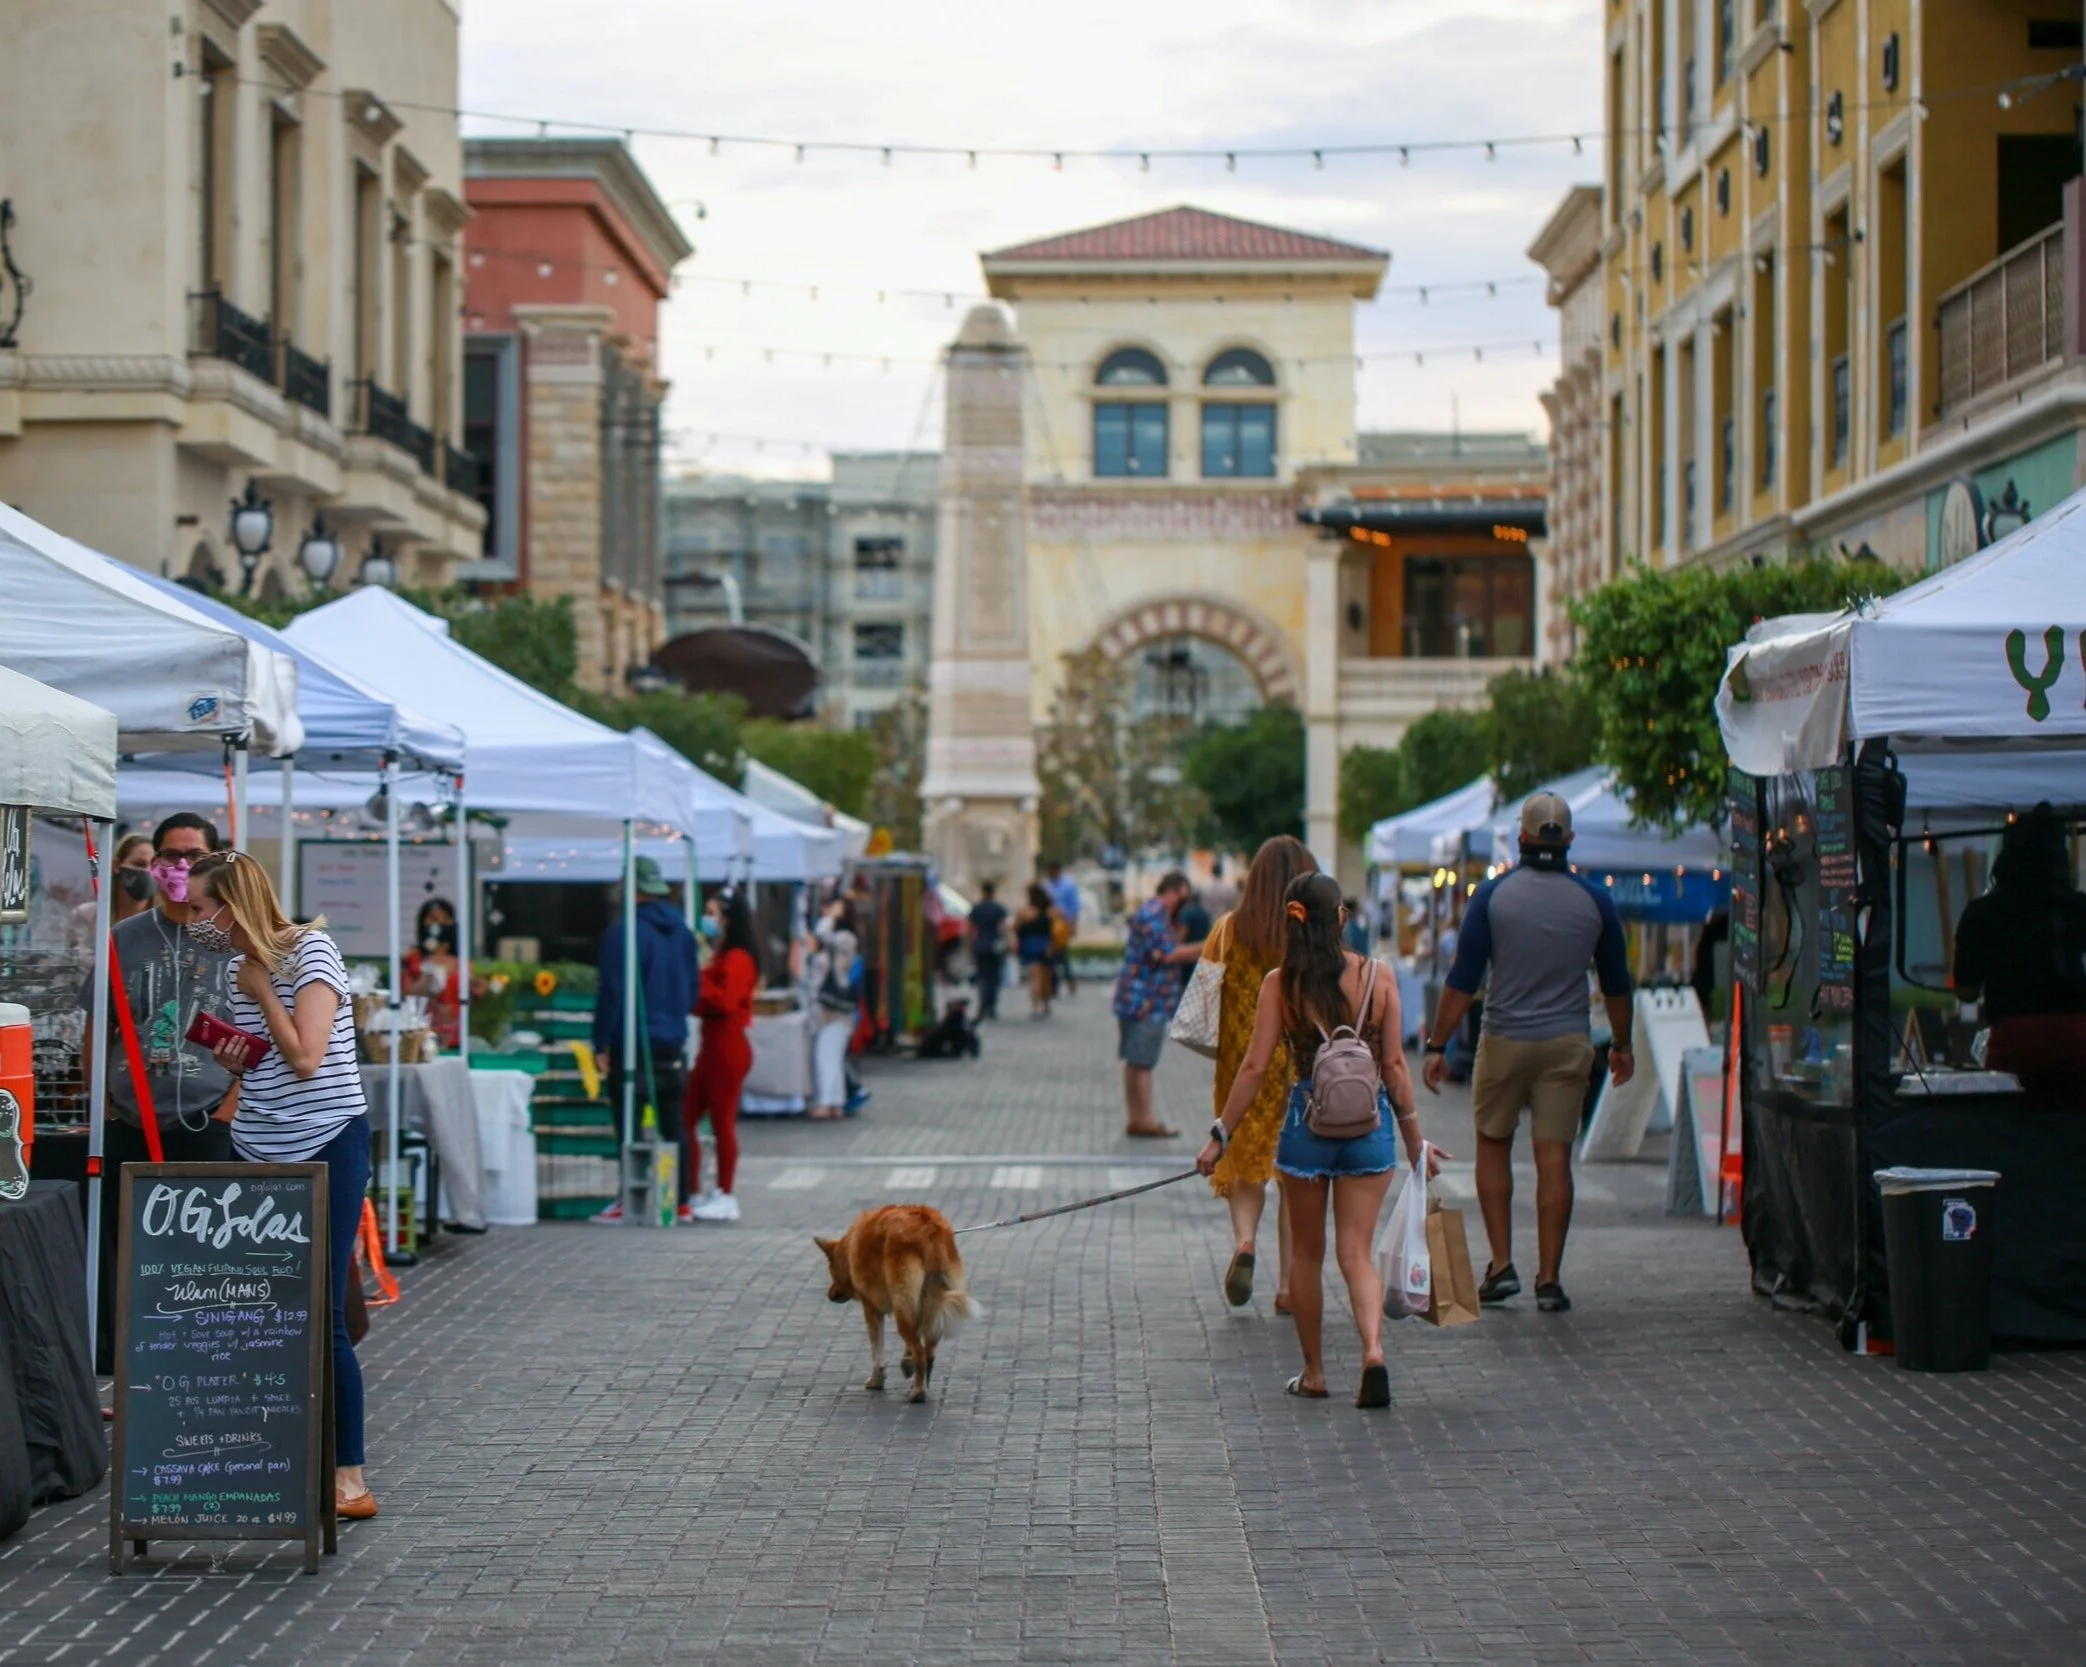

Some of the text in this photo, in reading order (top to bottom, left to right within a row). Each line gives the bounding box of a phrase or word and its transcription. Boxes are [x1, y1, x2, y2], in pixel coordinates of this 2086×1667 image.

[2005, 624, 2086, 722] Y
[140, 1263, 165, 1274] 100%
[171, 1263, 205, 1274] VEGAN
[245, 1263, 269, 1274] SOUL
[195, 1309, 265, 1326] SINIGANG
[253, 1328, 260, 1336] a
[264, 1325, 303, 1336] rainbow
[183, 1341, 220, 1354] veggies
[241, 1338, 284, 1351] jasmine
[211, 1350, 231, 1361] rice
[206, 1395, 241, 1405] LUMPIA
[175, 1434, 214, 1447] SWEETS
[154, 1464, 195, 1475] CASSAVA
[197, 1462, 220, 1477] CAKE
[219, 1492, 281, 1502] EMPANADAS
[194, 1513, 228, 1524] JUICE
